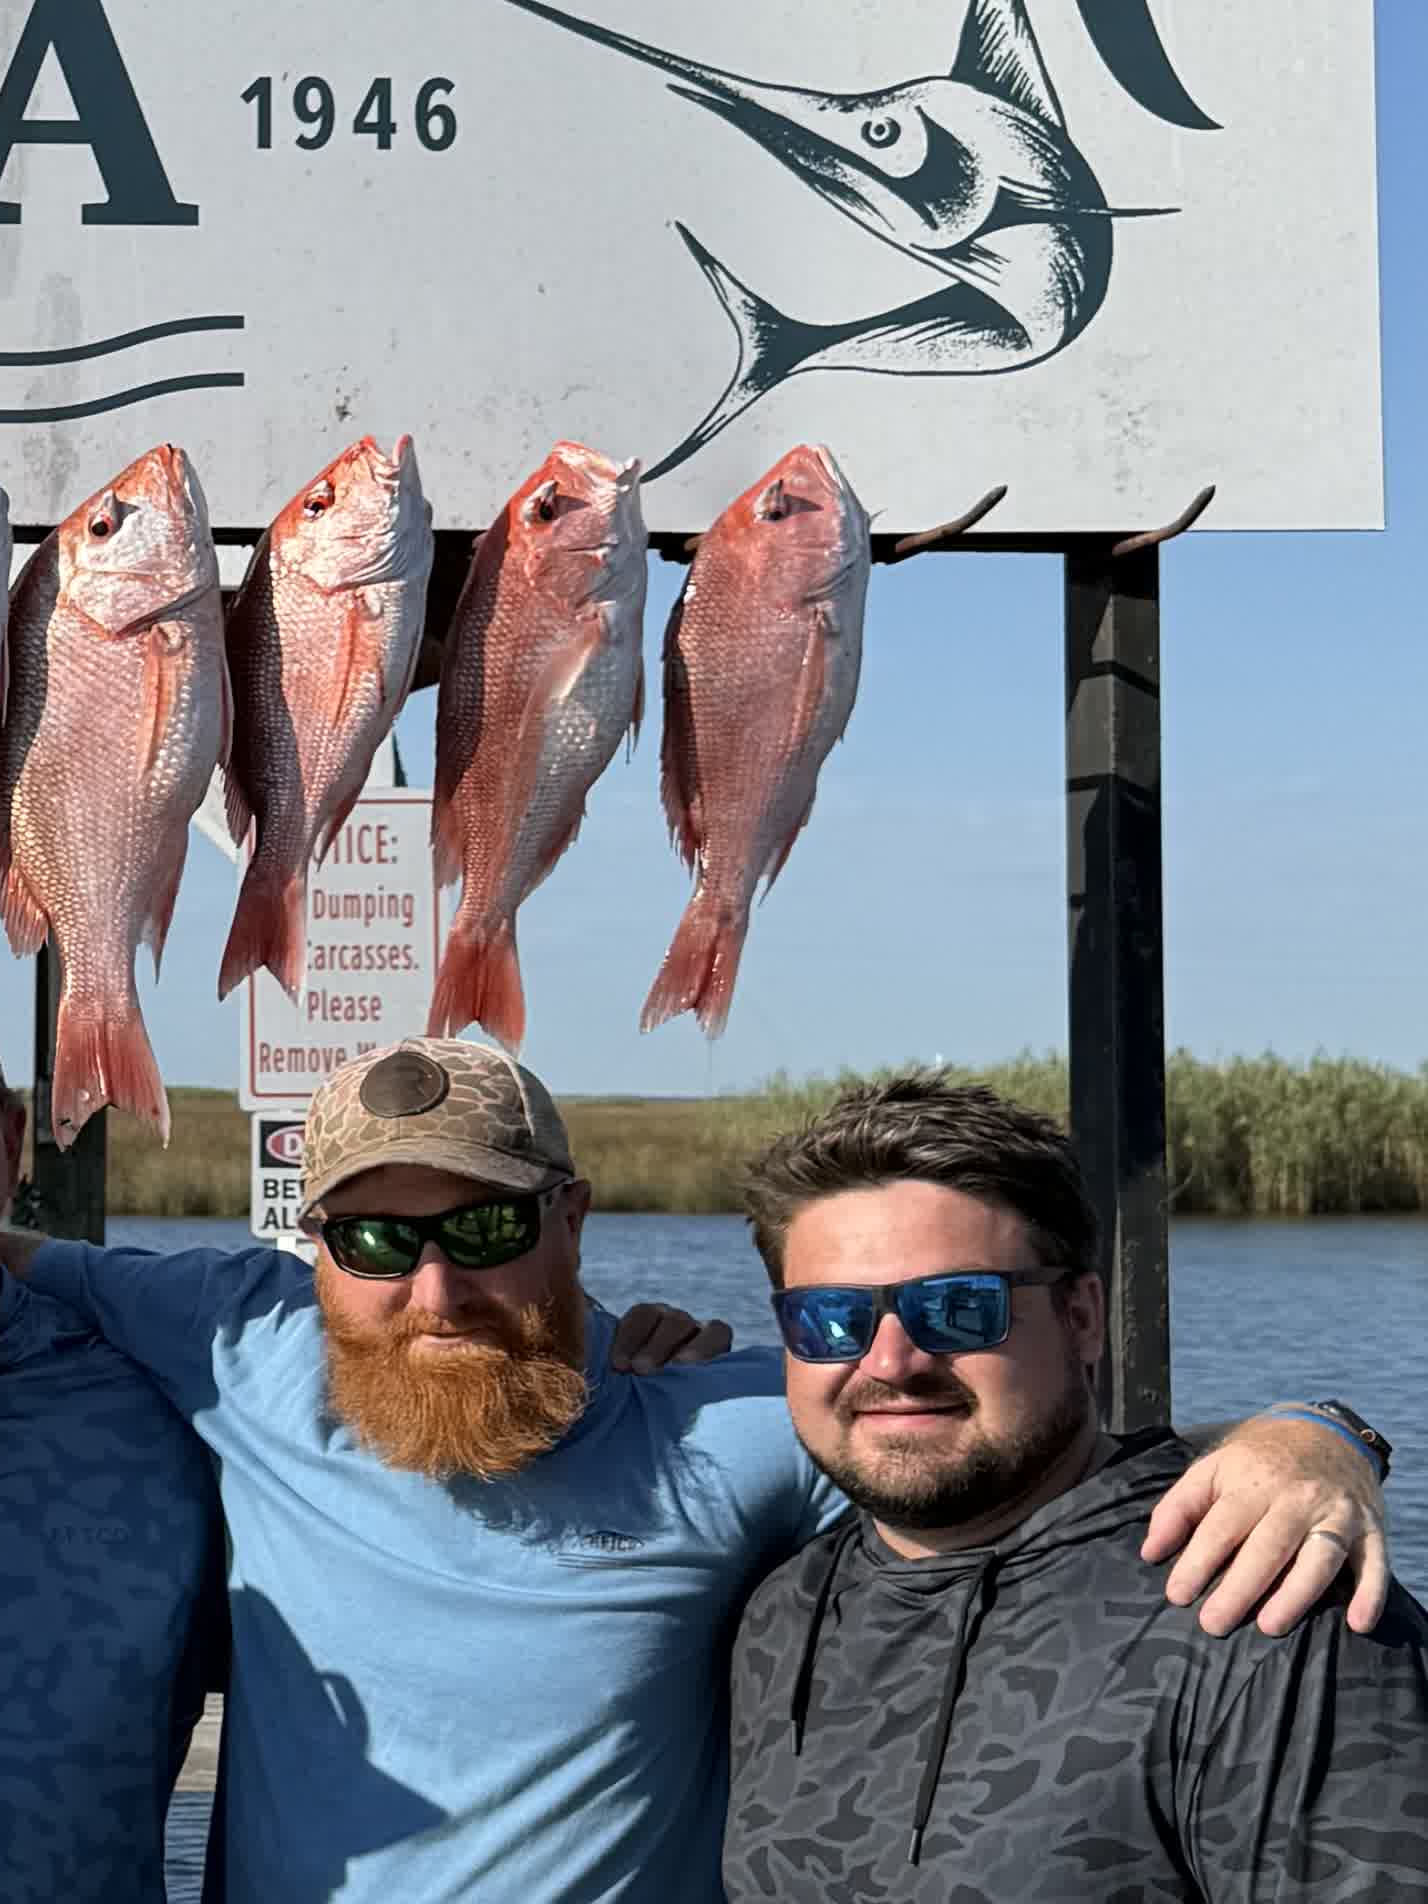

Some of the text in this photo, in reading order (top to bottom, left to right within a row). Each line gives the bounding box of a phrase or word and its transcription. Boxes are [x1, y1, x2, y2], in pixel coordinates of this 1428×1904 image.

[240, 77, 456, 151] 1946
[312, 885, 414, 928] Dumping
[307, 940, 419, 971] arcasses.
[307, 989, 382, 1022] Please
